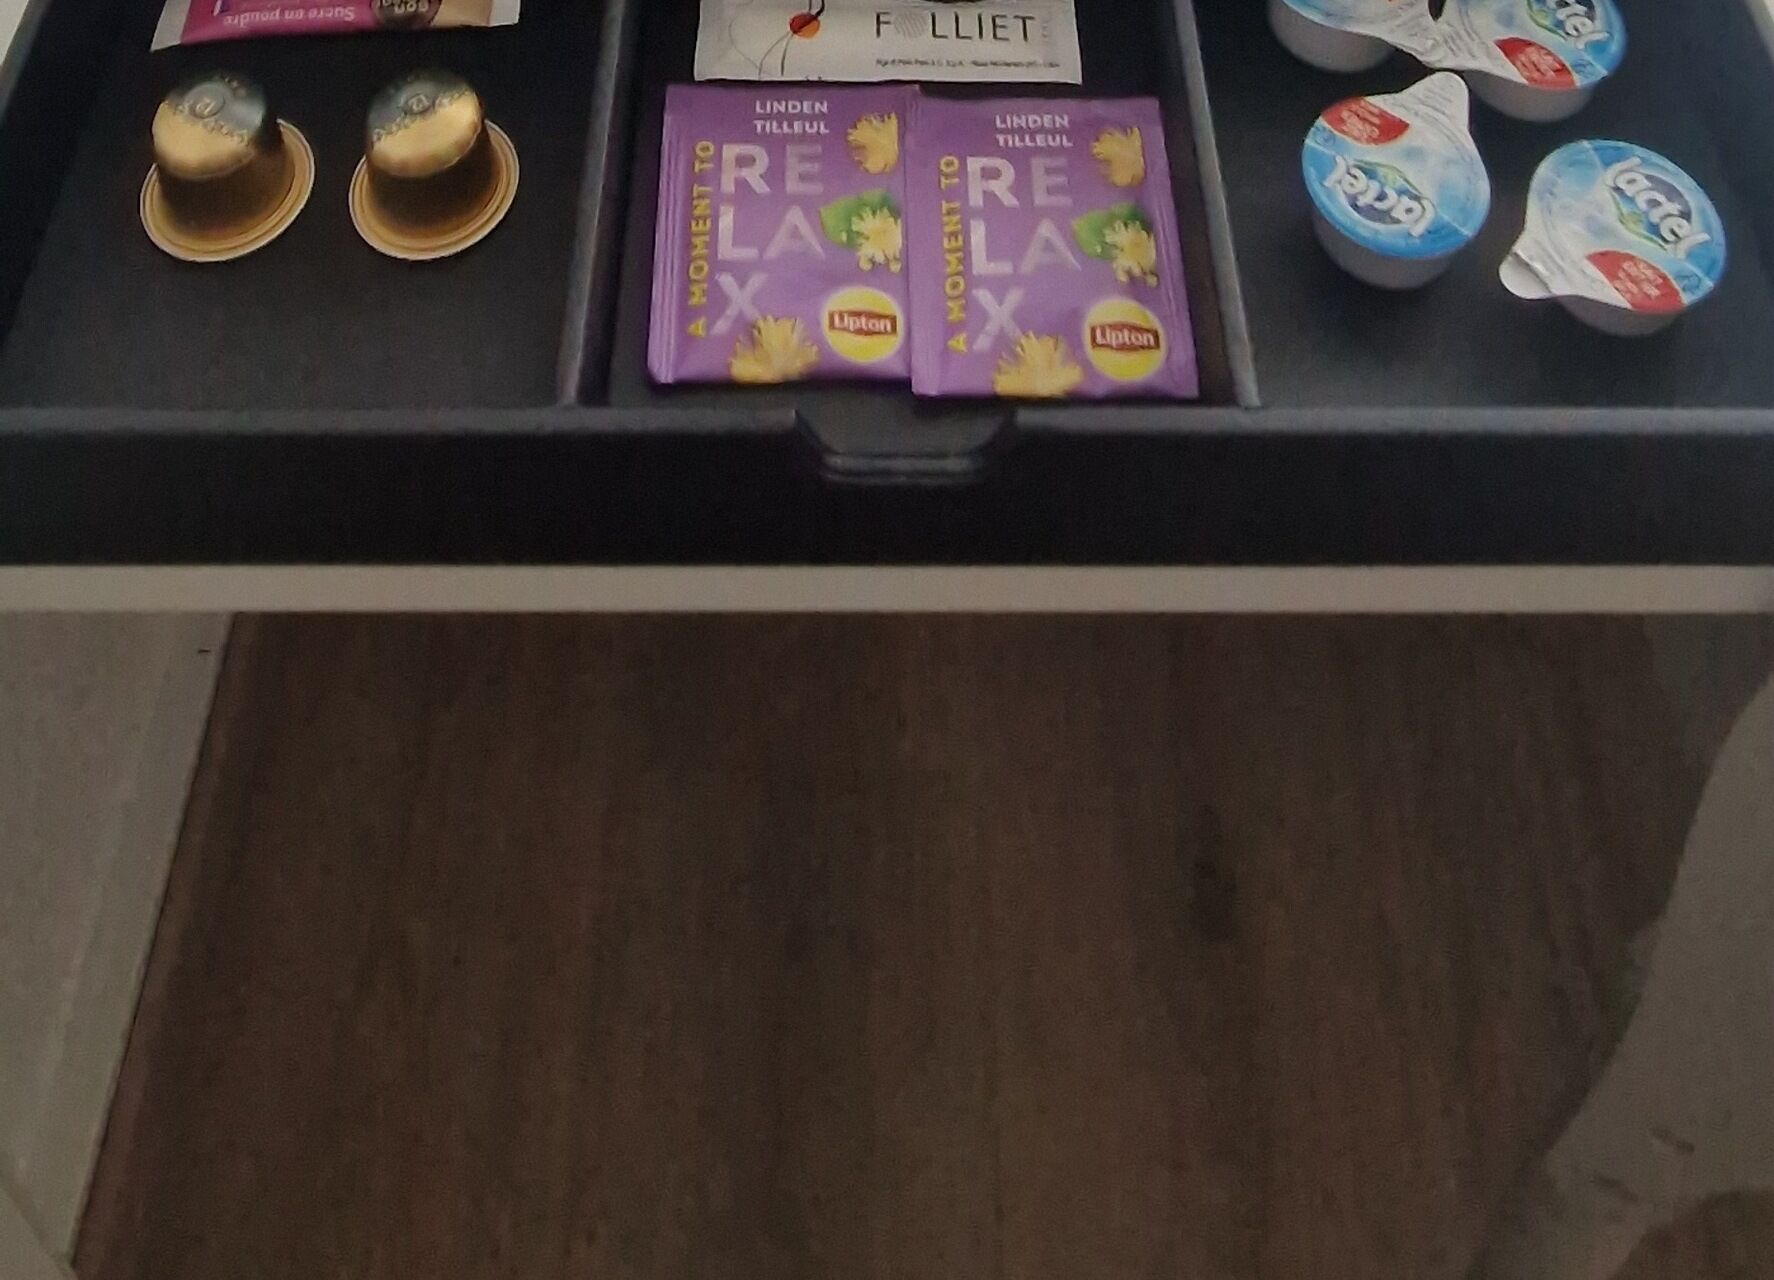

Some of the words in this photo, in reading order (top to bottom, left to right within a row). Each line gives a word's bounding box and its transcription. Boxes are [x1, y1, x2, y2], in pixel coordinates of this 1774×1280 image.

[223, 8, 280, 28] poudre
[308, 6, 356, 22] Sucre
[755, 100, 828, 115] LINDEN
[753, 119, 830, 135] TILLEUL
[995, 114, 1070, 129] LINDEN
[996, 133, 1074, 148] TILLEUL
[694, 140, 715, 174] TO
[939, 155, 961, 190] TO
[688, 183, 712, 306] MOMENT
[941, 200, 966, 323] MOMENT
[688, 316, 707, 338] A
[833, 310, 893, 333] Lipton
[947, 333, 968, 354] A
[1095, 325, 1156, 348] Lipton
